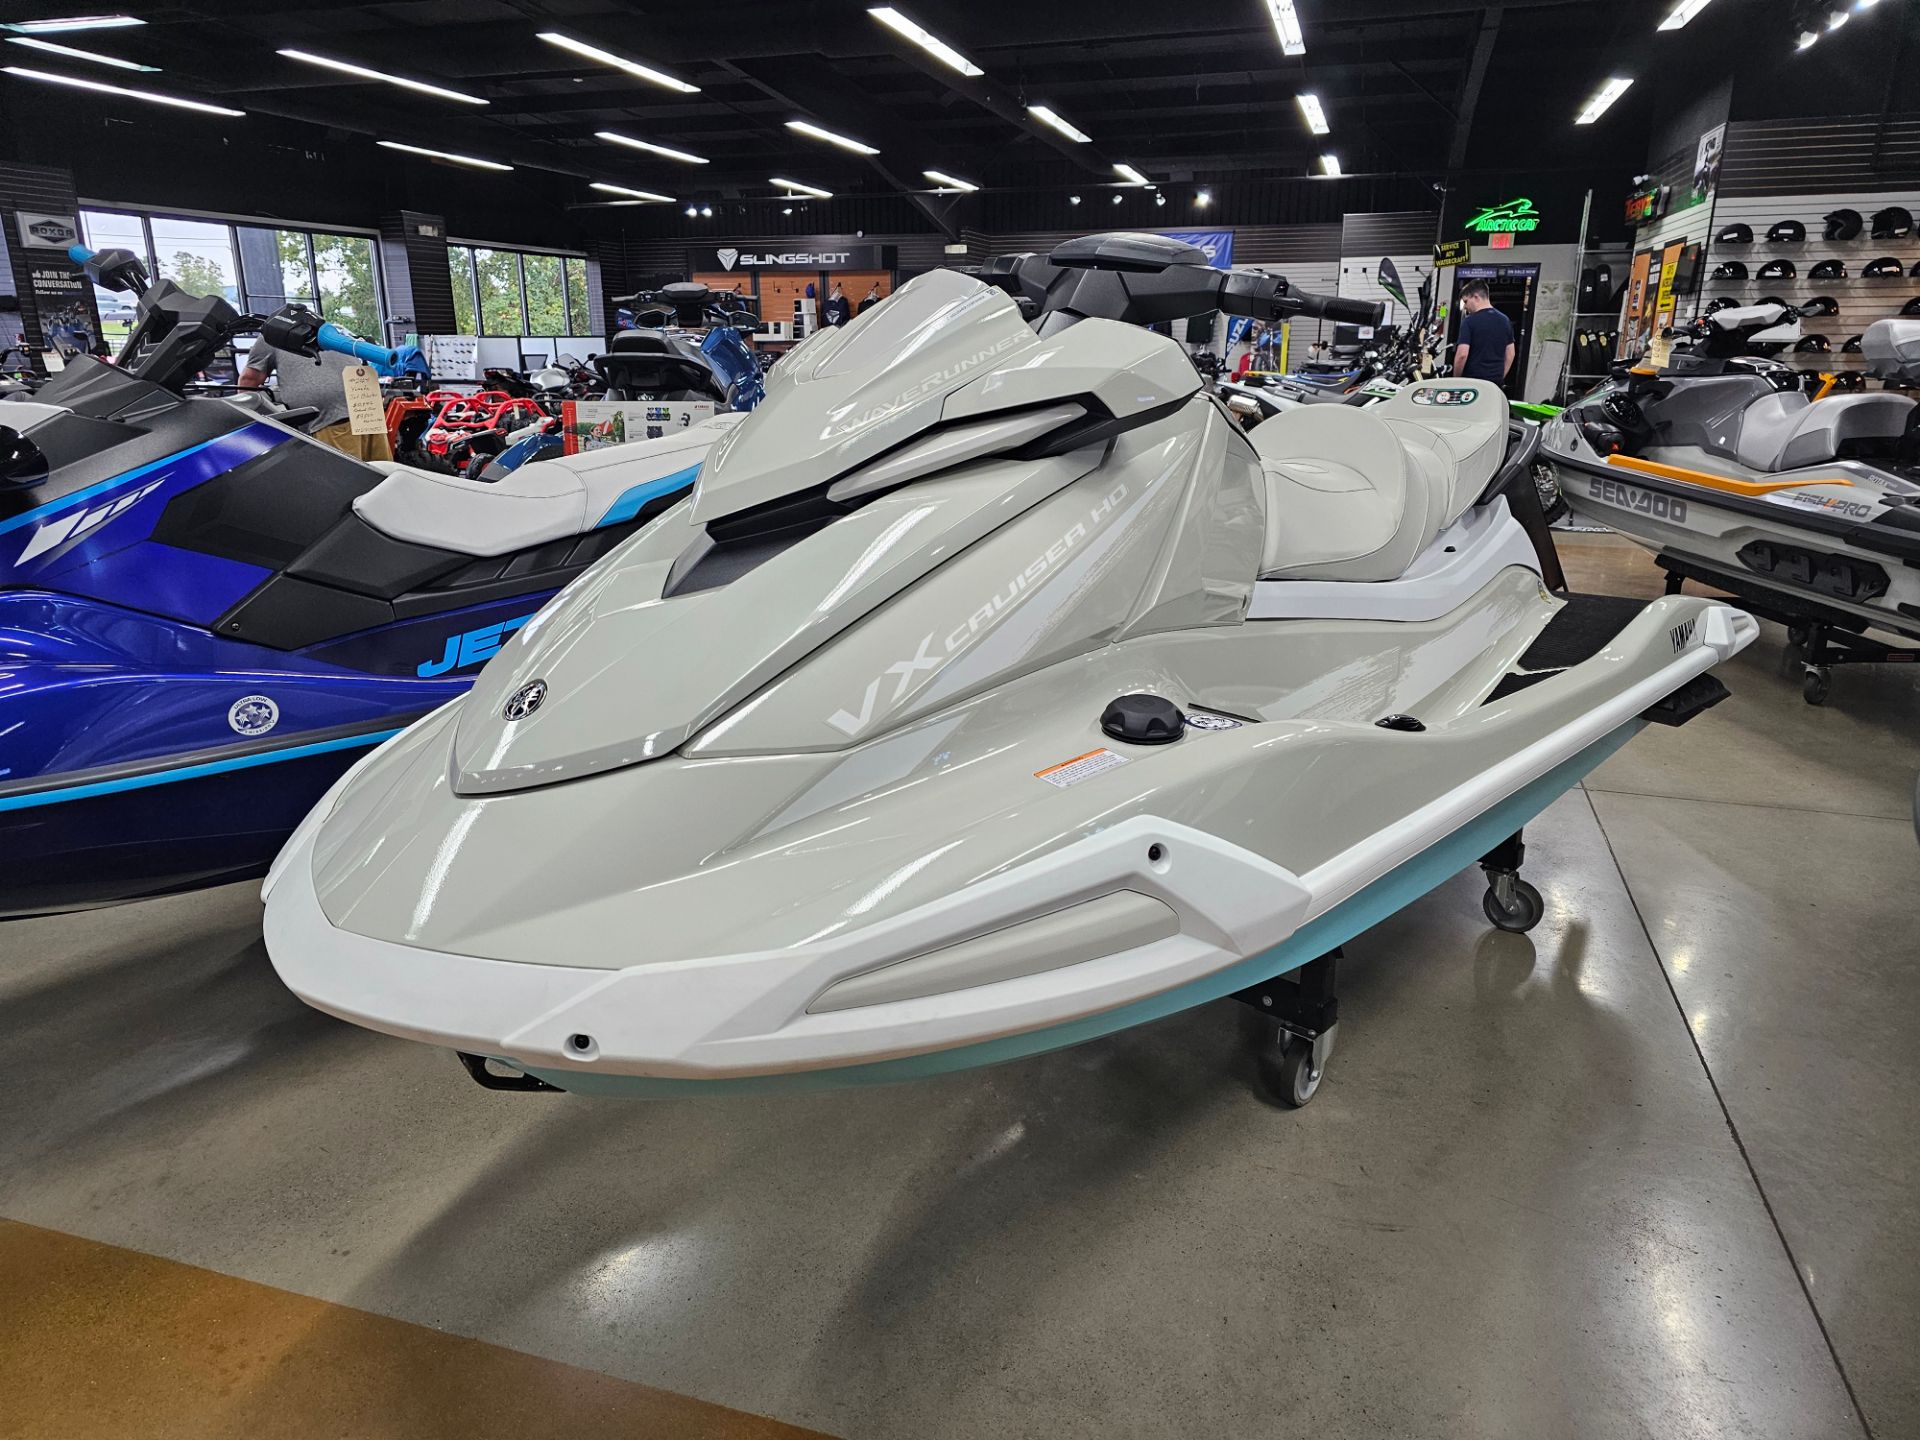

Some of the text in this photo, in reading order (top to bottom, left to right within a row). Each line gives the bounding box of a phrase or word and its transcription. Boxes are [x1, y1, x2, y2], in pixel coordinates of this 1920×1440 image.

[31, 226, 74, 237] ROXOR
[1476, 219, 1539, 232] ARCTIC CAT
[1441, 243, 1460, 252] SERVICE
[739, 252, 850, 266] SLINGSHOT
[1435, 255, 1466, 267] WATERCRAFT
[42, 270, 58, 279] JOIN
[33, 280, 82, 289] CONVERSATION
[838, 329, 1030, 431] WAVERUNNER
[826, 484, 1130, 736] VX CRUISER HO
